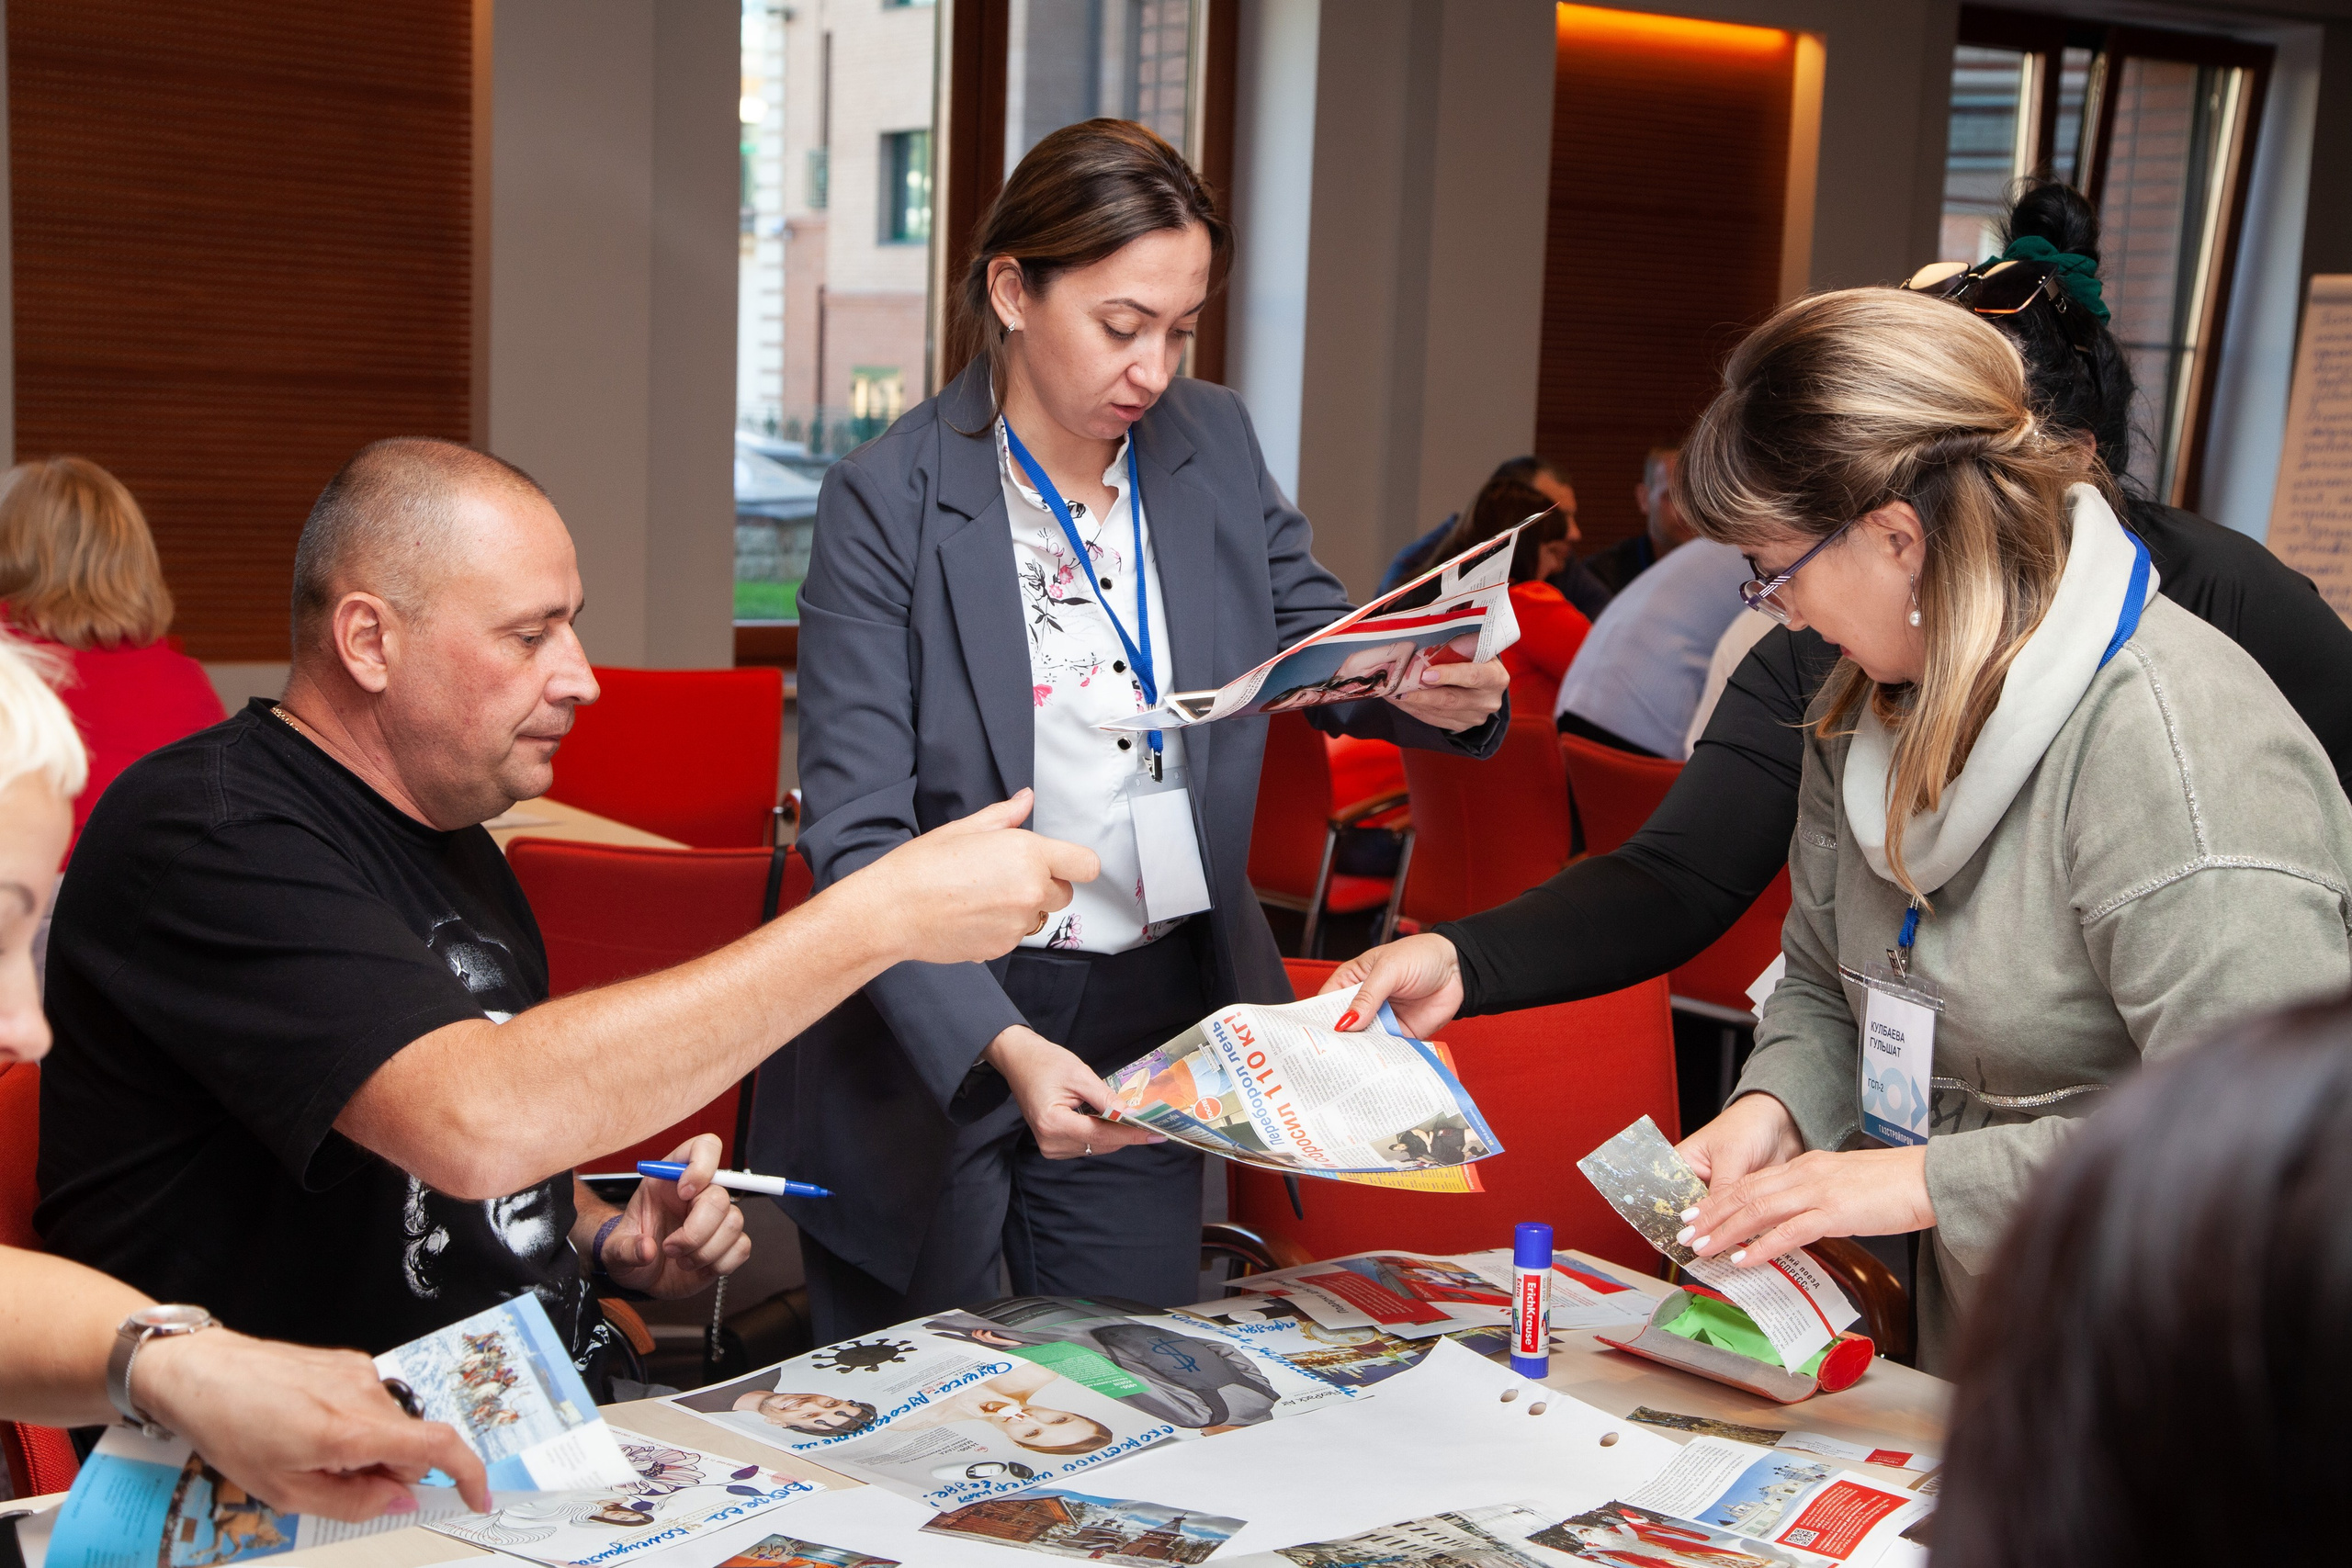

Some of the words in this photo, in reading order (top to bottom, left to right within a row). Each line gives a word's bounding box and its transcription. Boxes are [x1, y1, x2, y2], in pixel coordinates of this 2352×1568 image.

[1213, 1021, 1240, 1063] лень
[1224, 1012, 1256, 1047] кг!
[1871, 1021, 1905, 1043] КУЛБАЕВА
[1870, 1037, 1901, 1057] ГУЛЬШАТ
[1247, 1051, 1283, 1100] 110
[1868, 1078, 1883, 1092] ГСП-2
[1200, 1098, 1215, 1119] ПОСЛЕ
[1236, 1066, 1285, 1145] Переборол
[1277, 1102, 1330, 1164] сбросил
[1878, 1124, 1913, 1145] ГАЗСТРОЙПРОМ
[1772, 1257, 1810, 1291] КСПРЕСС»
[1798, 1266, 1820, 1289] поезд
[1525, 1282, 1536, 1346] ErichKrause
[1062, 1425, 1174, 1472] скоростной
